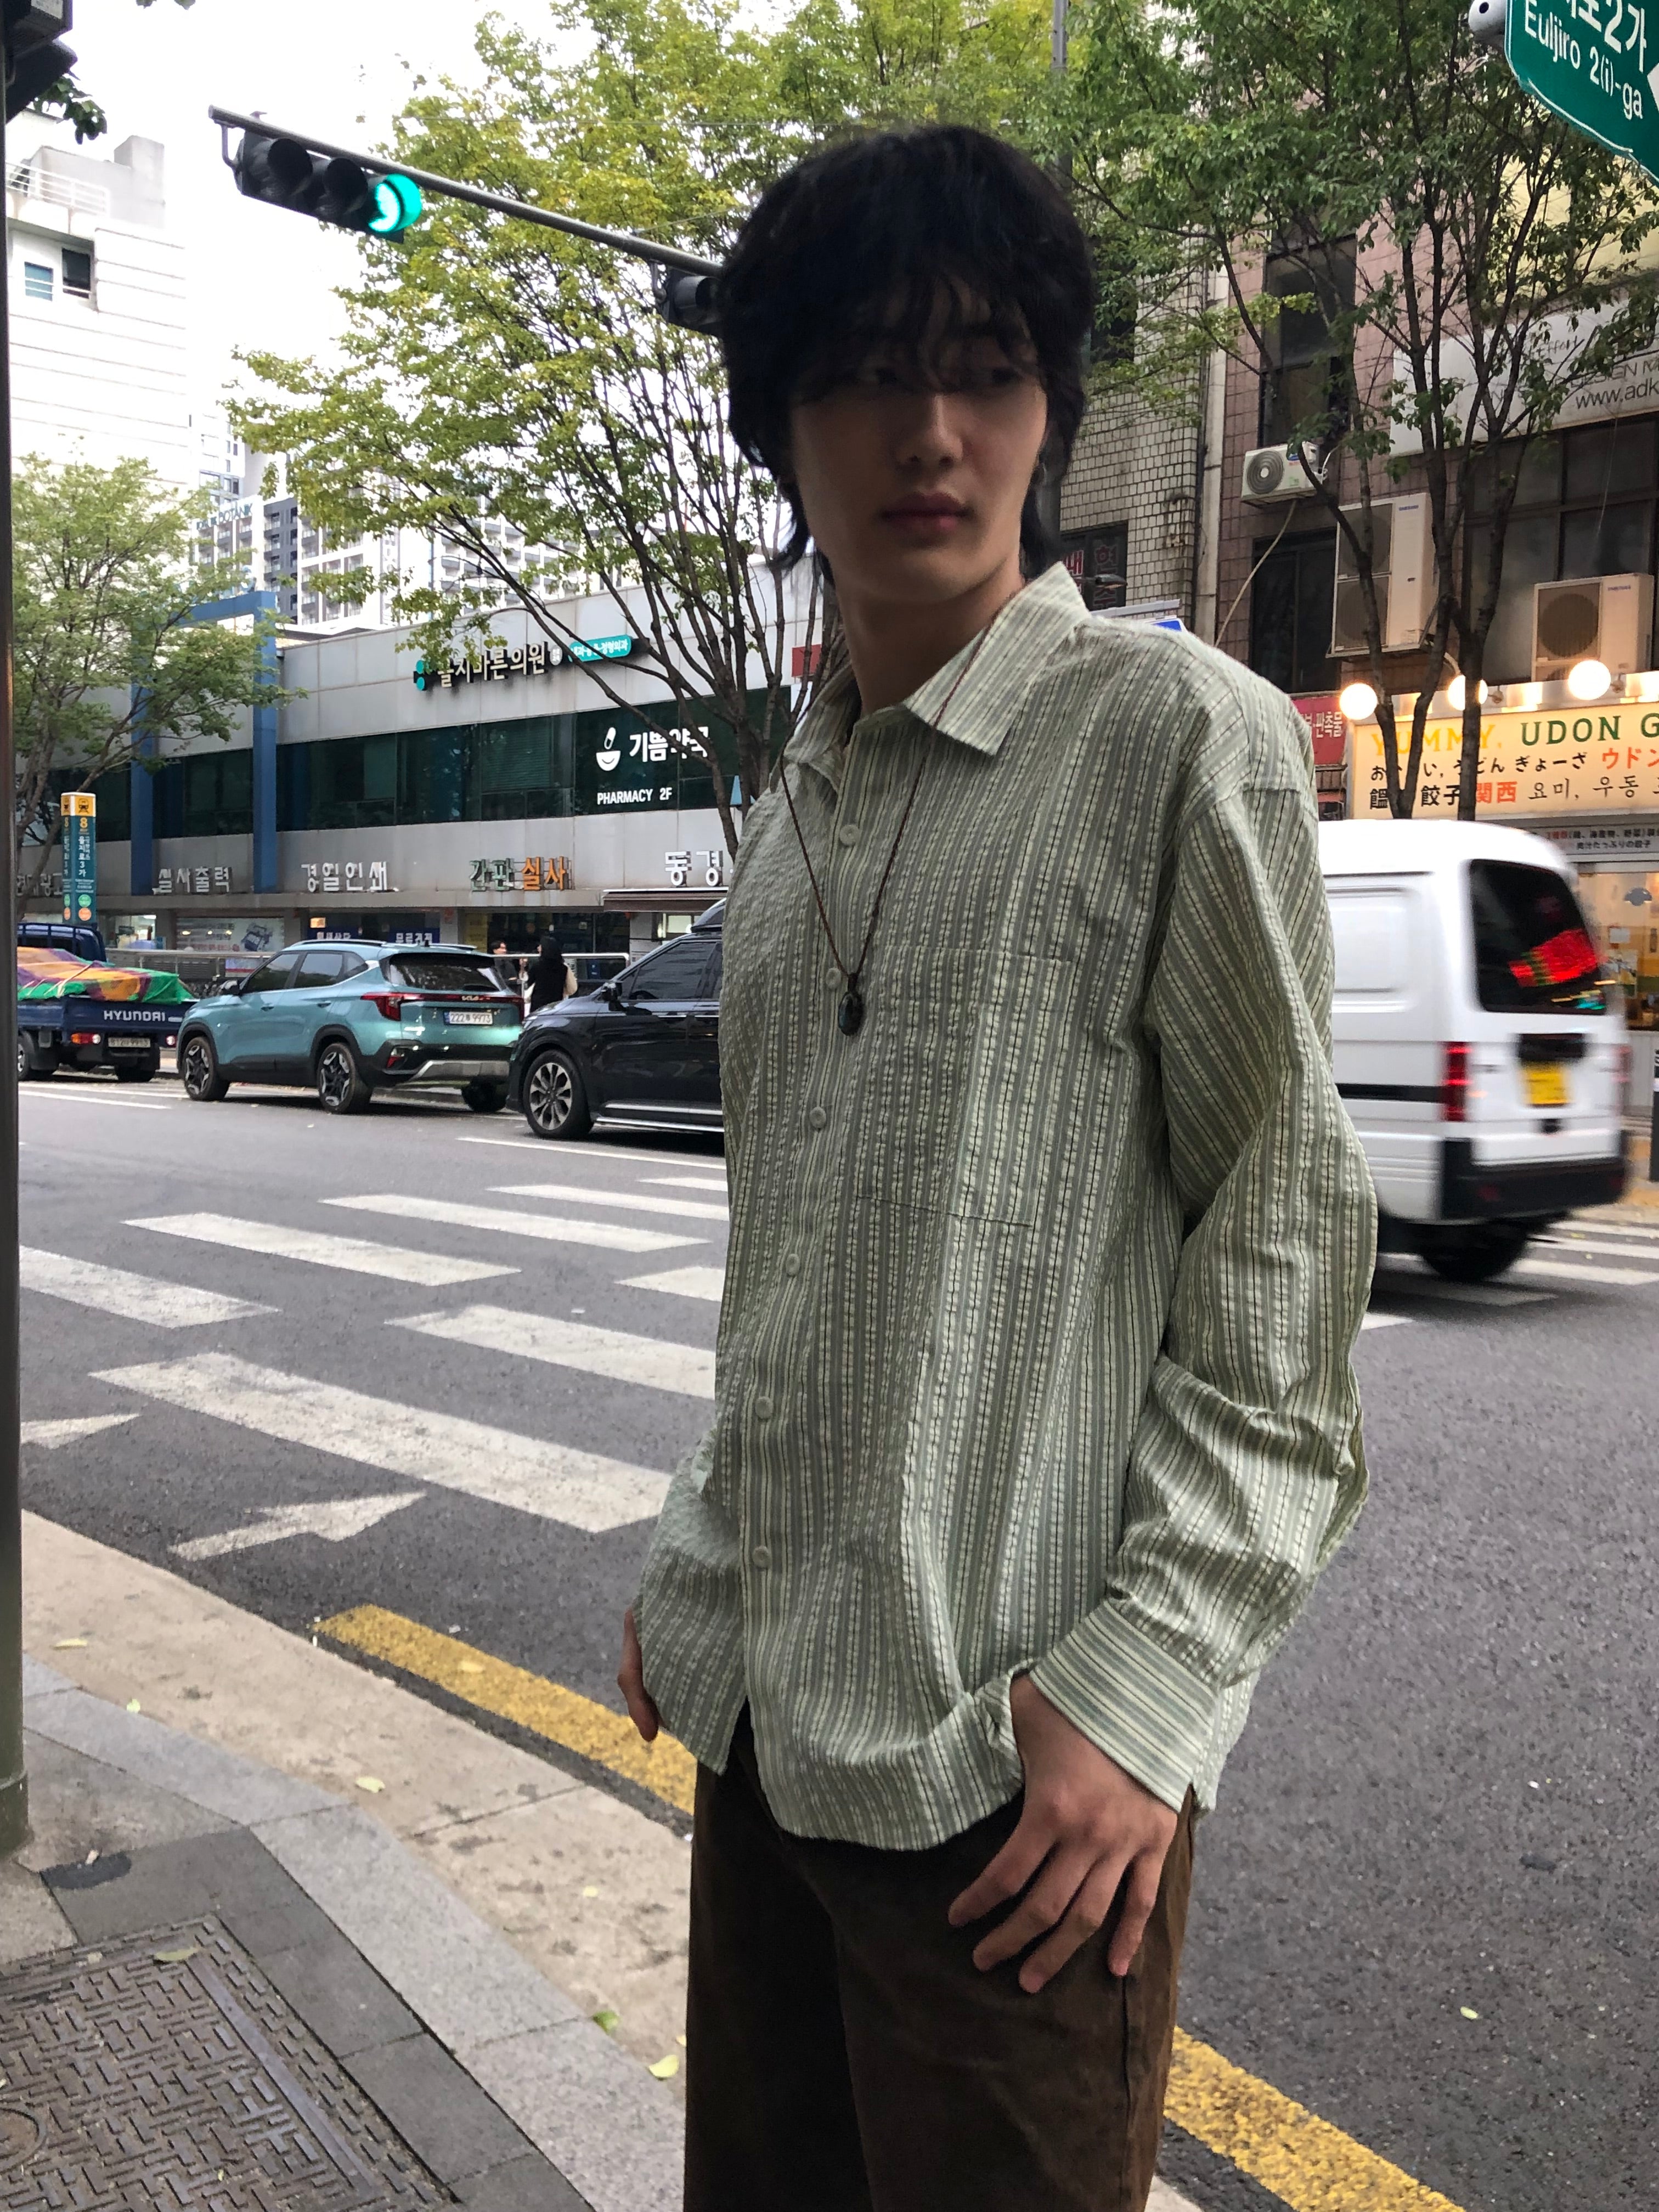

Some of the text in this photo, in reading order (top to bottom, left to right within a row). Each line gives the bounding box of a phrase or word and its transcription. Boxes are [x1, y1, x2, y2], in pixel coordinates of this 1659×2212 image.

[1525, 0, 1643, 120] Euljiro 2(i)-ga
[629, 726, 709, 763] 기쁨약국
[1521, 715, 1621, 746] UDON
[597, 787, 673, 805] PHARMACY 2F
[1593, 775, 1639, 798] 우동
[79, 817, 88, 828] 8
[159, 866, 230, 893] 실사출력
[301, 861, 388, 893] 경일인쇄
[470, 855, 566, 891] 간판 실사
[664, 850, 733, 887] 동경
[104, 1010, 166, 1022] HYUNDAI
